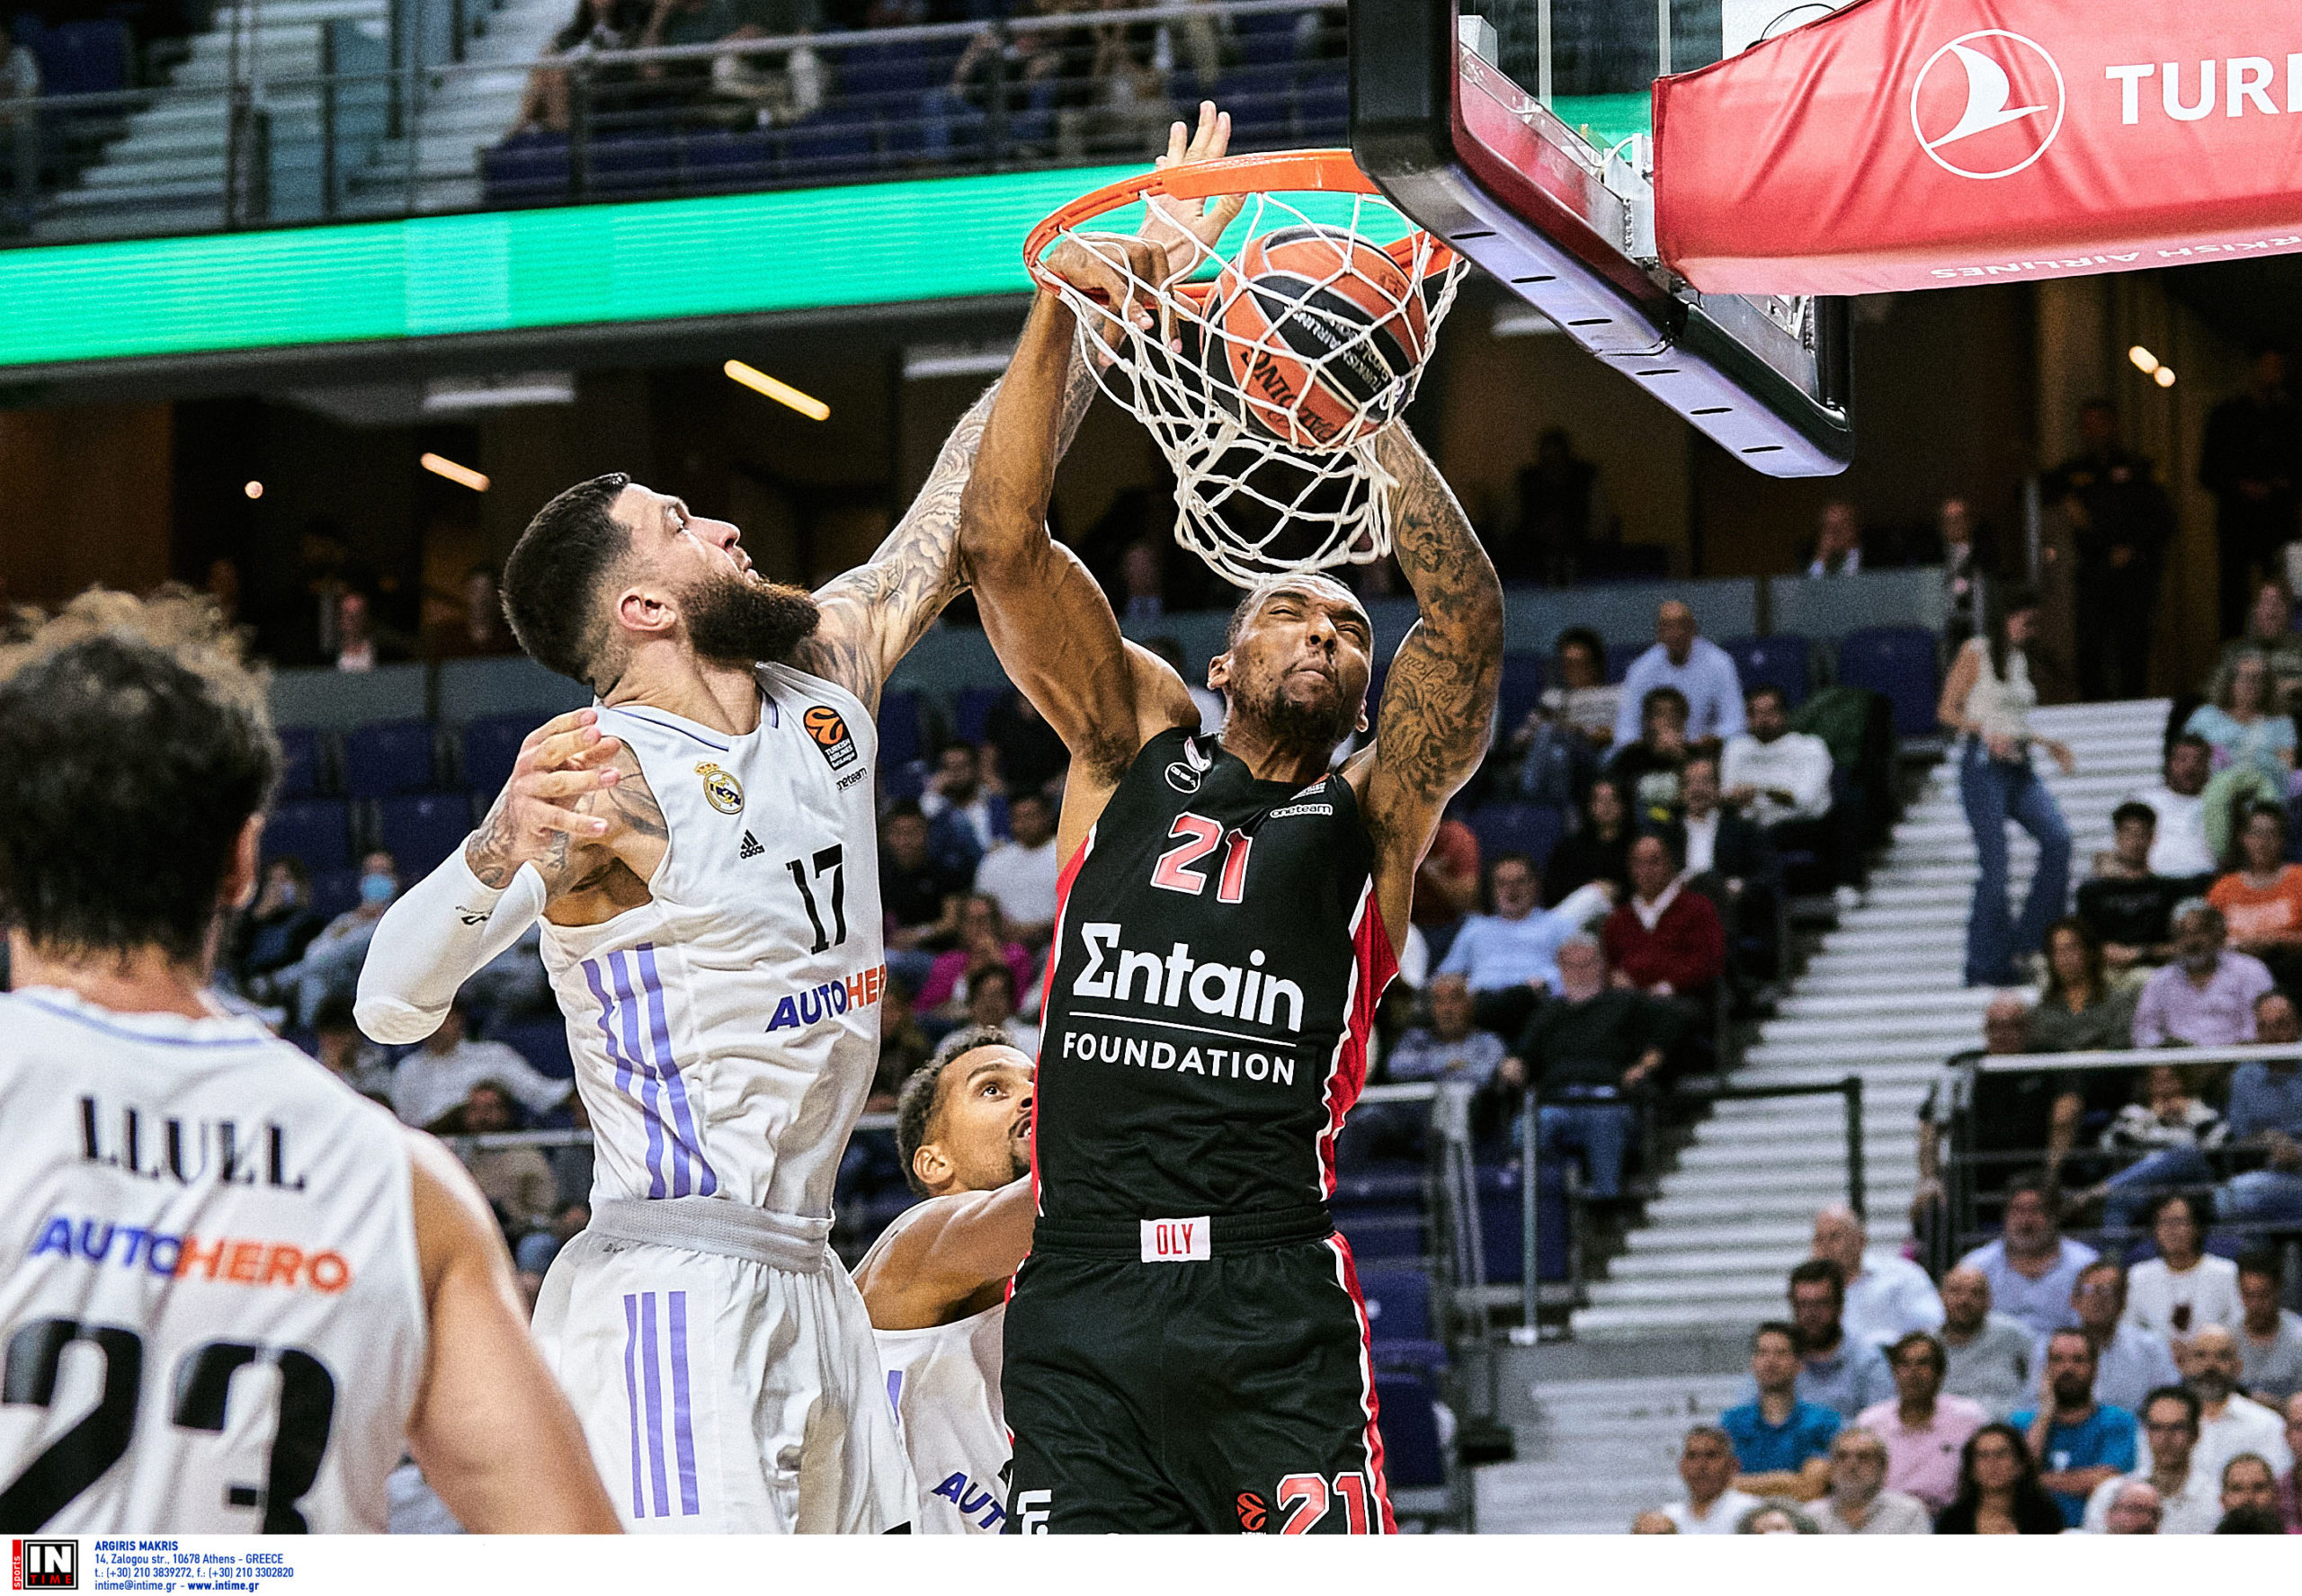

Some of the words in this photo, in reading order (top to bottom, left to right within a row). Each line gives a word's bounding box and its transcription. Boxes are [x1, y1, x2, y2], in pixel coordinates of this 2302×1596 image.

[1930, 251, 2140, 279] AIRLINES
[1150, 811, 1253, 904] 21
[785, 843, 846, 955] 17
[1062, 1031, 1295, 1085] FOUNDATION
[81, 1095, 306, 1190] LLULL
[30, 1217, 352, 1292] AUTOHERO
[1156, 1224, 1193, 1255] OLY
[0, 1319, 335, 1534] 23
[931, 1472, 1006, 1534] AUT
[1277, 1472, 1370, 1534] 21
